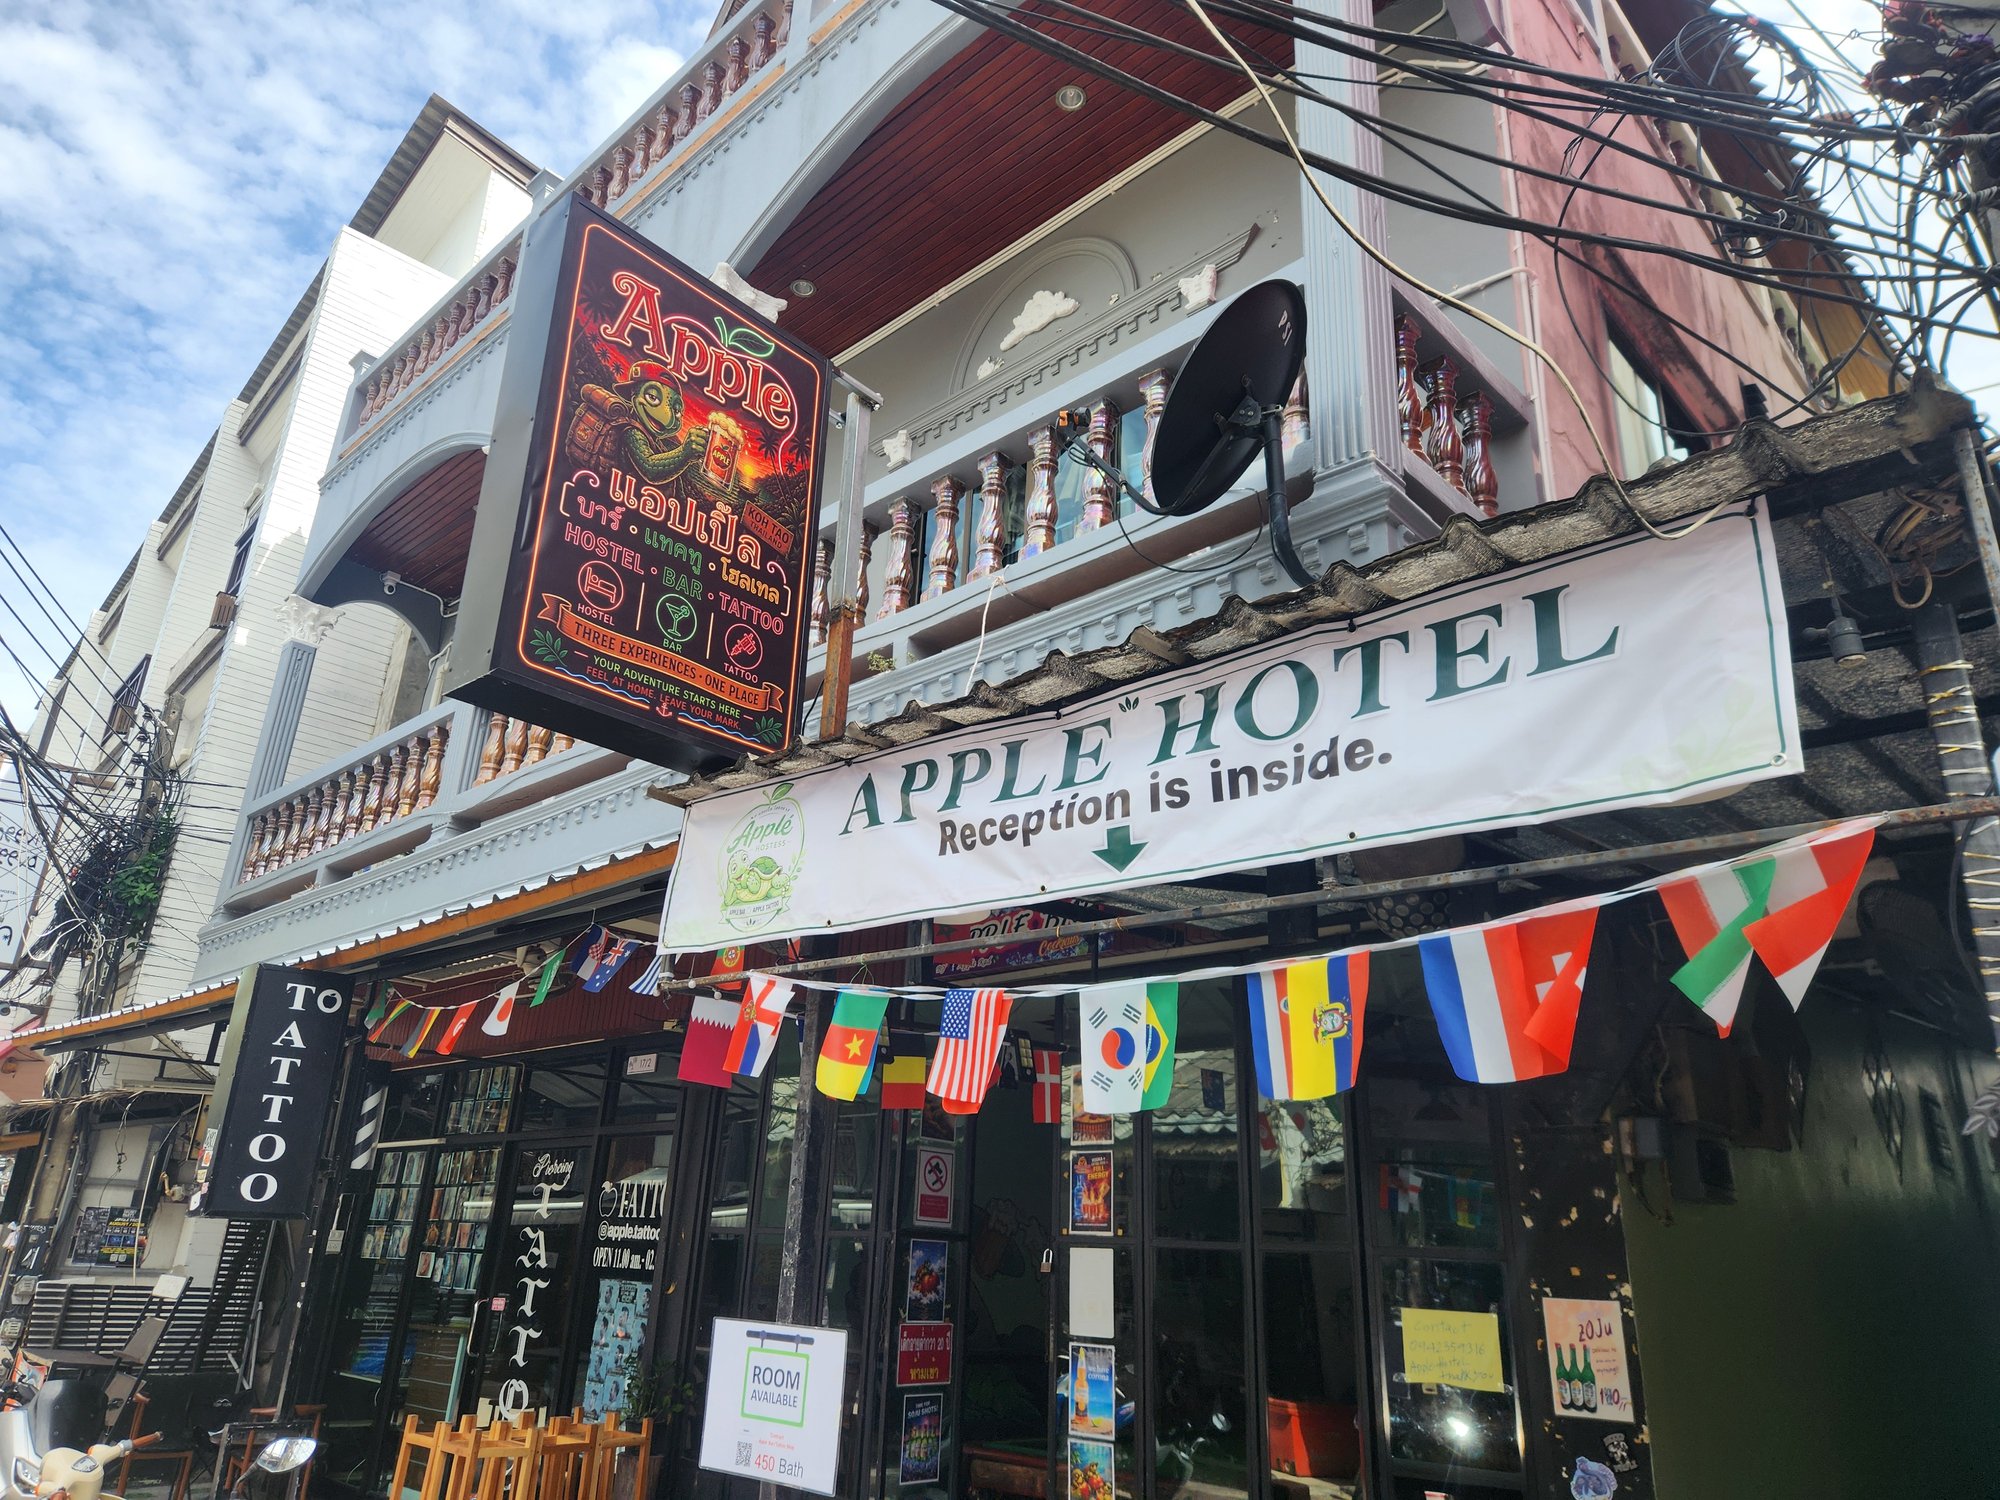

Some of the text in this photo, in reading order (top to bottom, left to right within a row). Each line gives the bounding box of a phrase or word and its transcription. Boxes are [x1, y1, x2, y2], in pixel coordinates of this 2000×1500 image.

[601, 271, 791, 429] Apple
[713, 449, 731, 466] APPLE
[577, 496, 626, 531] บาร์
[610, 468, 760, 570] แอปเปิ้ล
[748, 507, 790, 544] KOH TAO
[750, 521, 783, 549] THAILAND
[565, 522, 784, 635] HOSTEL BAR TATTOO
[577, 603, 615, 626] HOSTEL
[663, 638, 682, 653] BAR
[575, 622, 759, 706] THREE EXPERIENCES ONE PLACE
[724, 662, 759, 684] TATTOO
[586, 666, 742, 731] FEEL AT HOME. LEAVE YOUR MARK.
[594, 655, 741, 719] YOUR ADVENTURE STARTS HERE
[839, 584, 1620, 836] APPLE HOTEL
[939, 735, 1393, 856] Reception is inside.
[593, 1246, 613, 1268] OPEN
[752, 1365, 800, 1391] ROOM
[751, 1389, 798, 1408] AVAILABLE
[755, 1454, 804, 1479] 450 Bath
